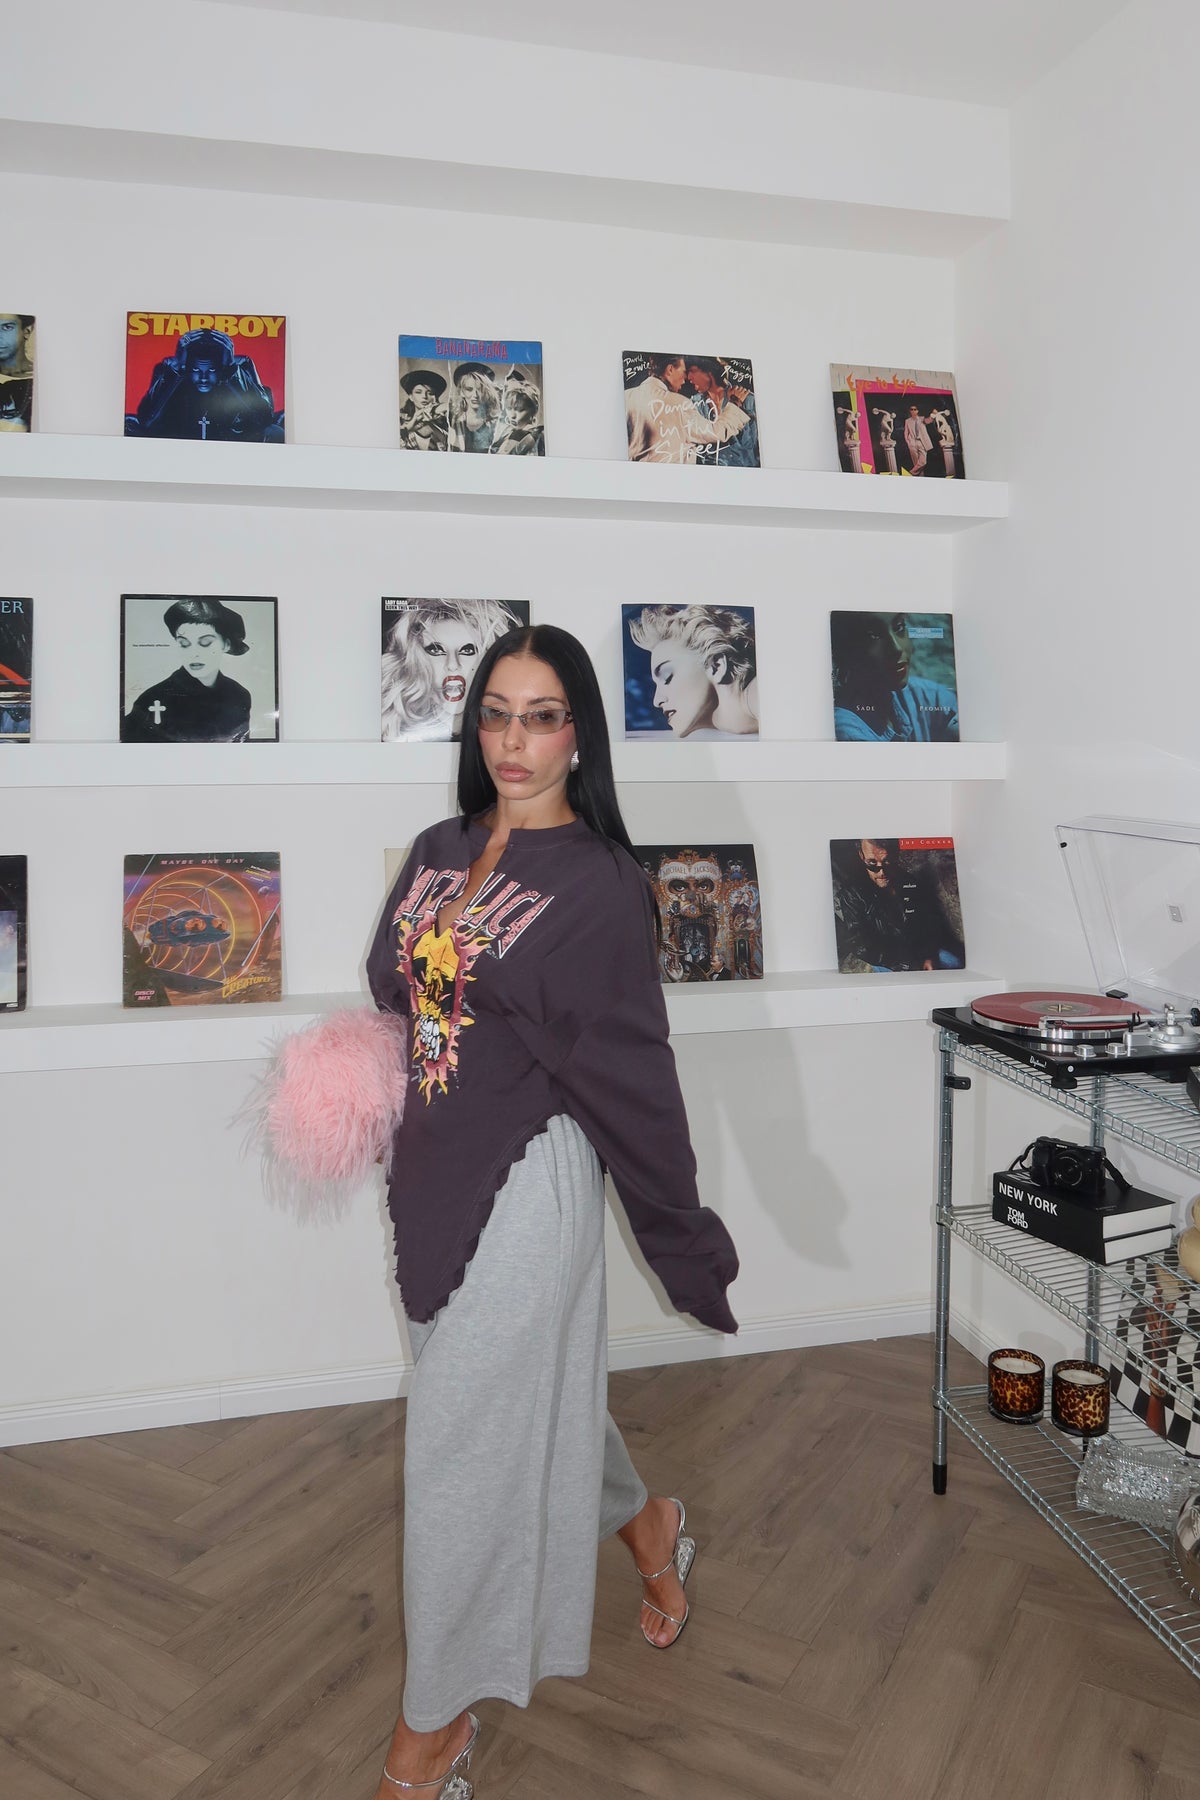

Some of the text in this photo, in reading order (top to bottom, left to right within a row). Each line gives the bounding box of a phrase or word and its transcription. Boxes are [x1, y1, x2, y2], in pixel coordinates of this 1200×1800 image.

[127, 312, 285, 338] STARBOY
[435, 338, 509, 360] BANANARAMA
[648, 398, 718, 423] Dancing
[999, 1181, 1058, 1216] NEW YORK
[1007, 1206, 1025, 1221] TOM
[1007, 1214, 1029, 1229] FORD
